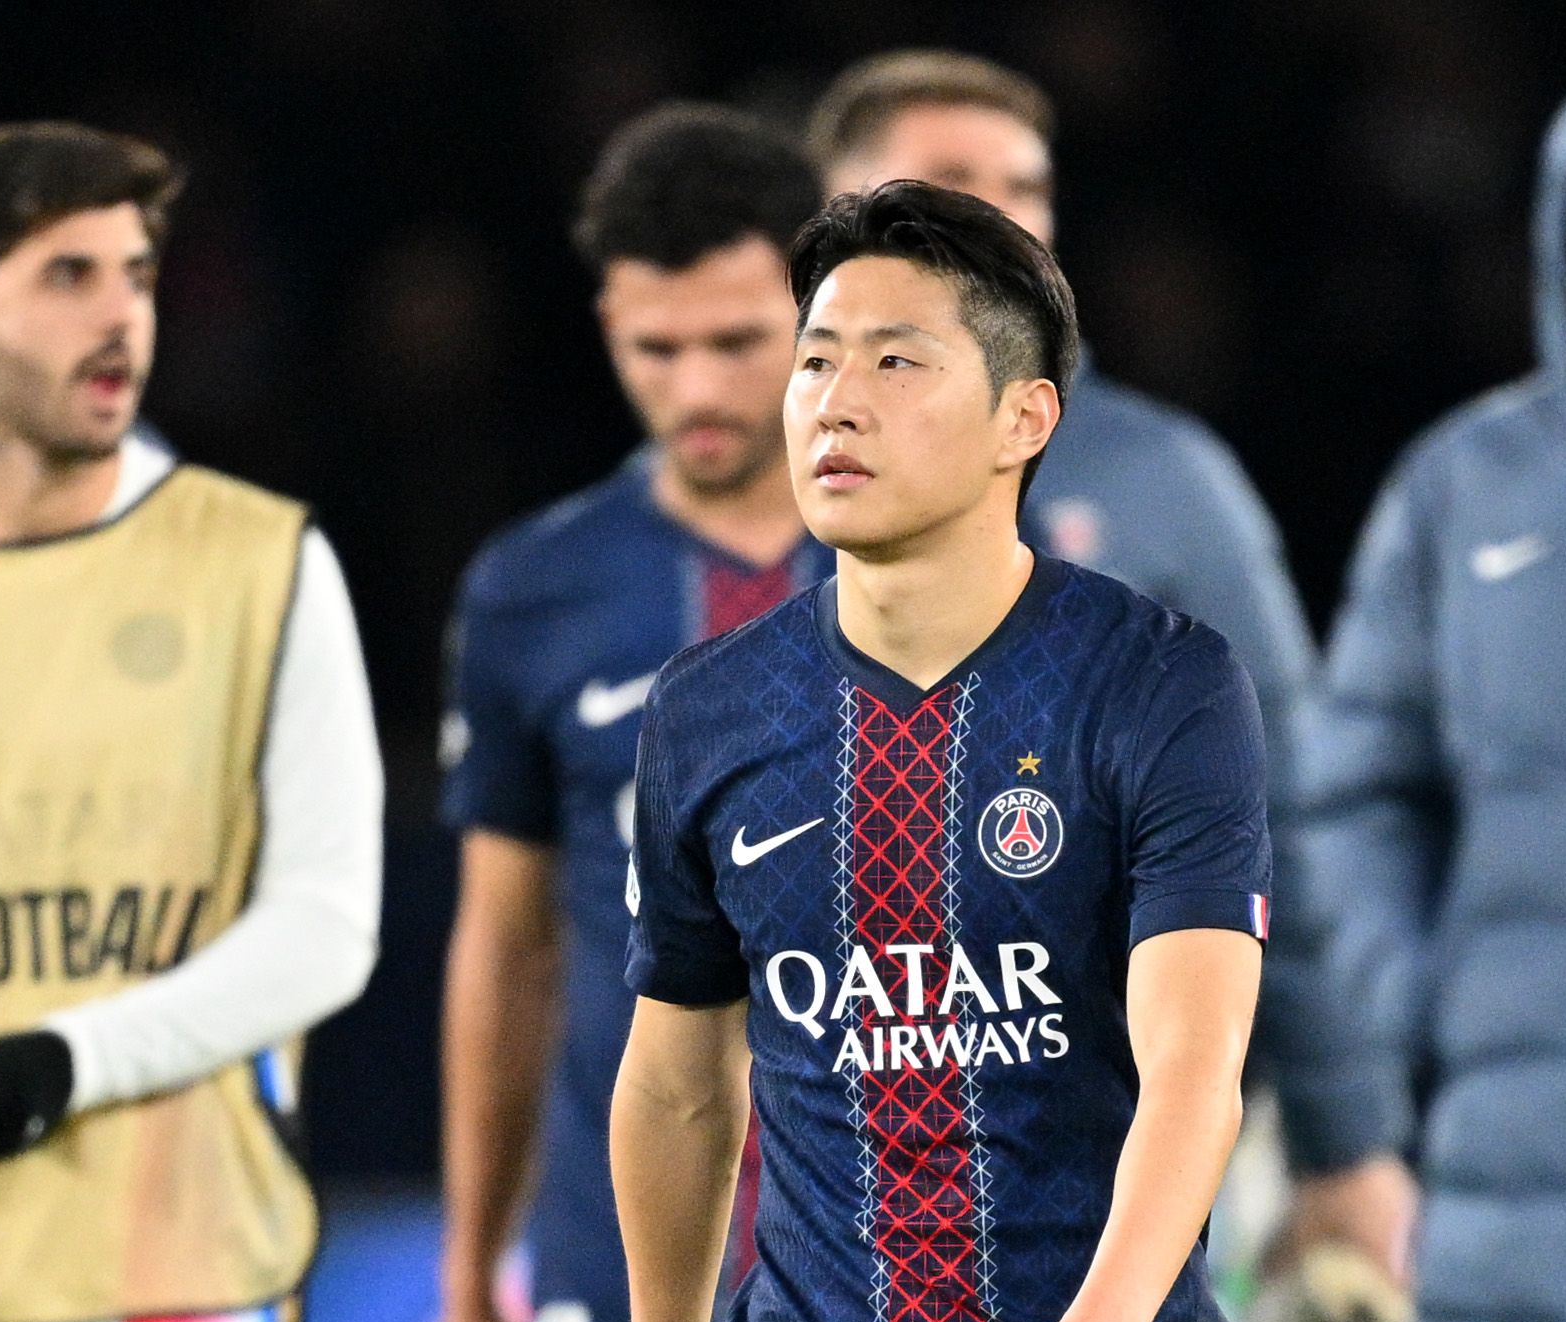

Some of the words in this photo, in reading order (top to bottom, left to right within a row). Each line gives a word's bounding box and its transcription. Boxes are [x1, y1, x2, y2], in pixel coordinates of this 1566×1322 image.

[994, 792, 1051, 817] PARIS
[765, 942, 1063, 1040] QATAR
[832, 1013, 1070, 1073] AIRWAYS
